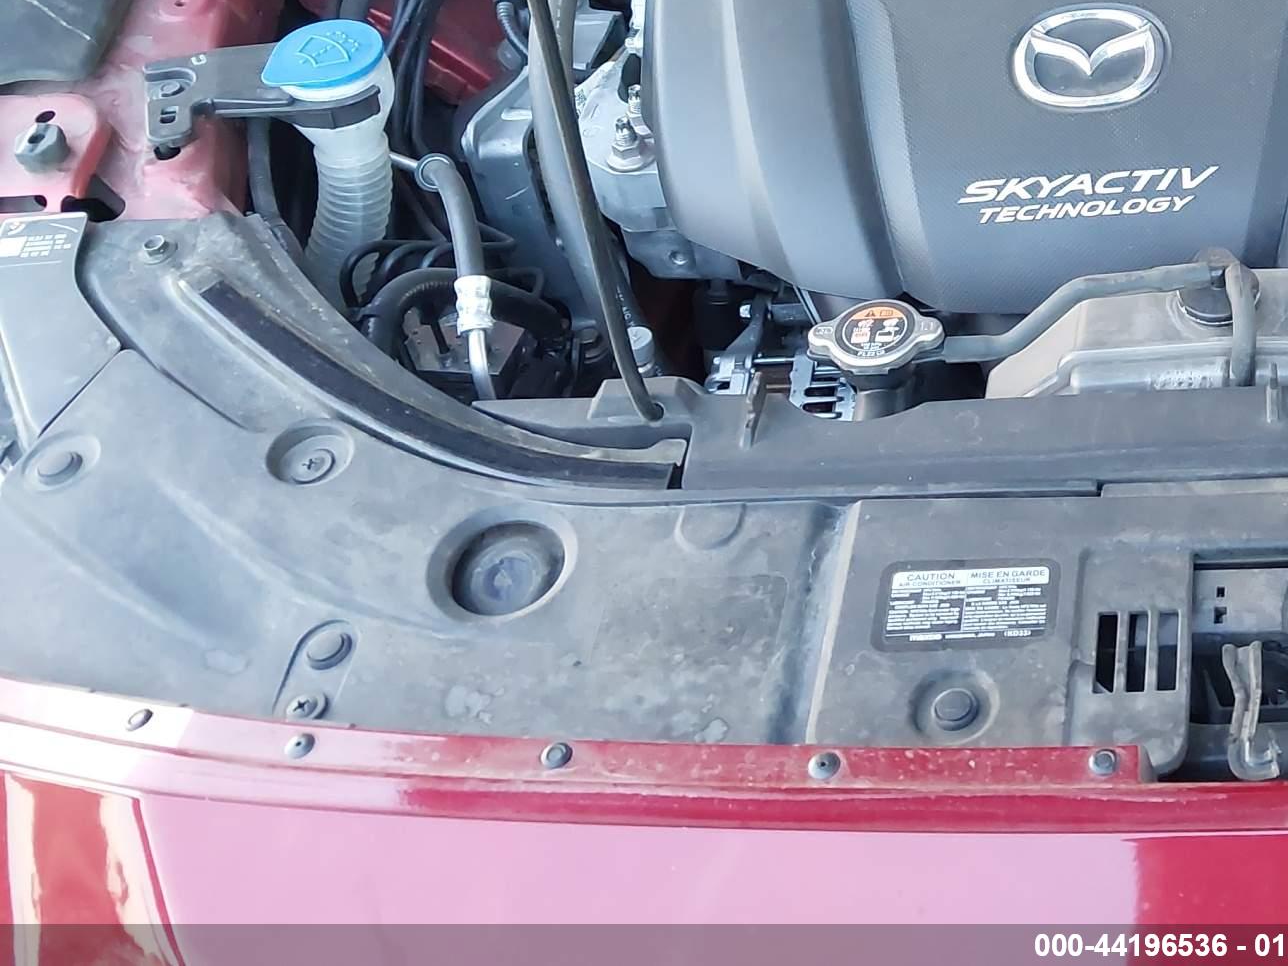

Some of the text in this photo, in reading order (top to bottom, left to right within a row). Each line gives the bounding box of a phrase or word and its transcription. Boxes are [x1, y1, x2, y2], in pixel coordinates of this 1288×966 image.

[957, 165, 1219, 204] SKYACTIV
[978, 195, 1196, 224] TECHNOLOGY
[906, 572, 956, 581] CAUTION
[970, 571, 994, 579] MISE
[1011, 569, 1046, 577] GARDE
[912, 579, 961, 587] CONDITIONER
